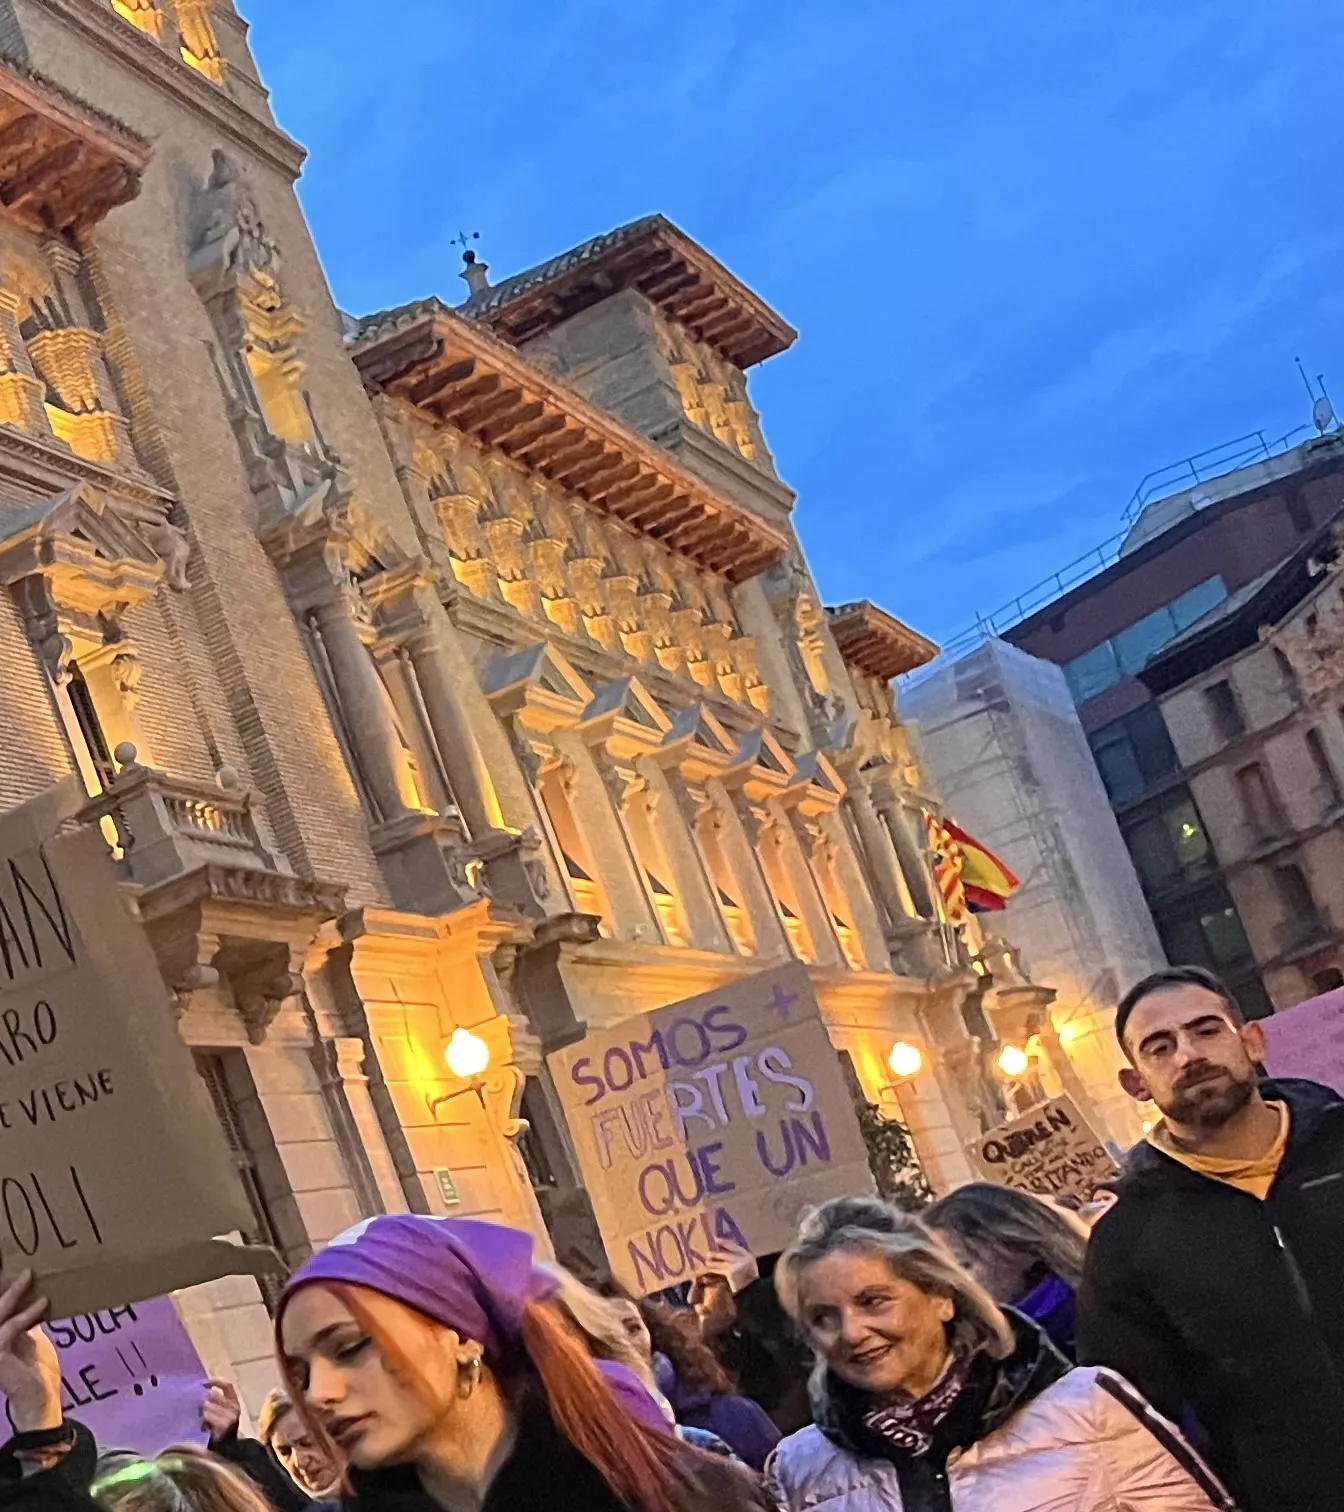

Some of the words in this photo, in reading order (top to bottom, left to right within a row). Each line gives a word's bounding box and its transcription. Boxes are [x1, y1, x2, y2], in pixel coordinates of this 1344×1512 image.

[19, 1069, 114, 1126] VIENE
[571, 1005, 747, 1105] SOMOS
[591, 1047, 815, 1171] FUERTES
[638, 1142, 735, 1216] QUE
[756, 1110, 831, 1177] UN
[627, 1207, 749, 1290] NOKIA
